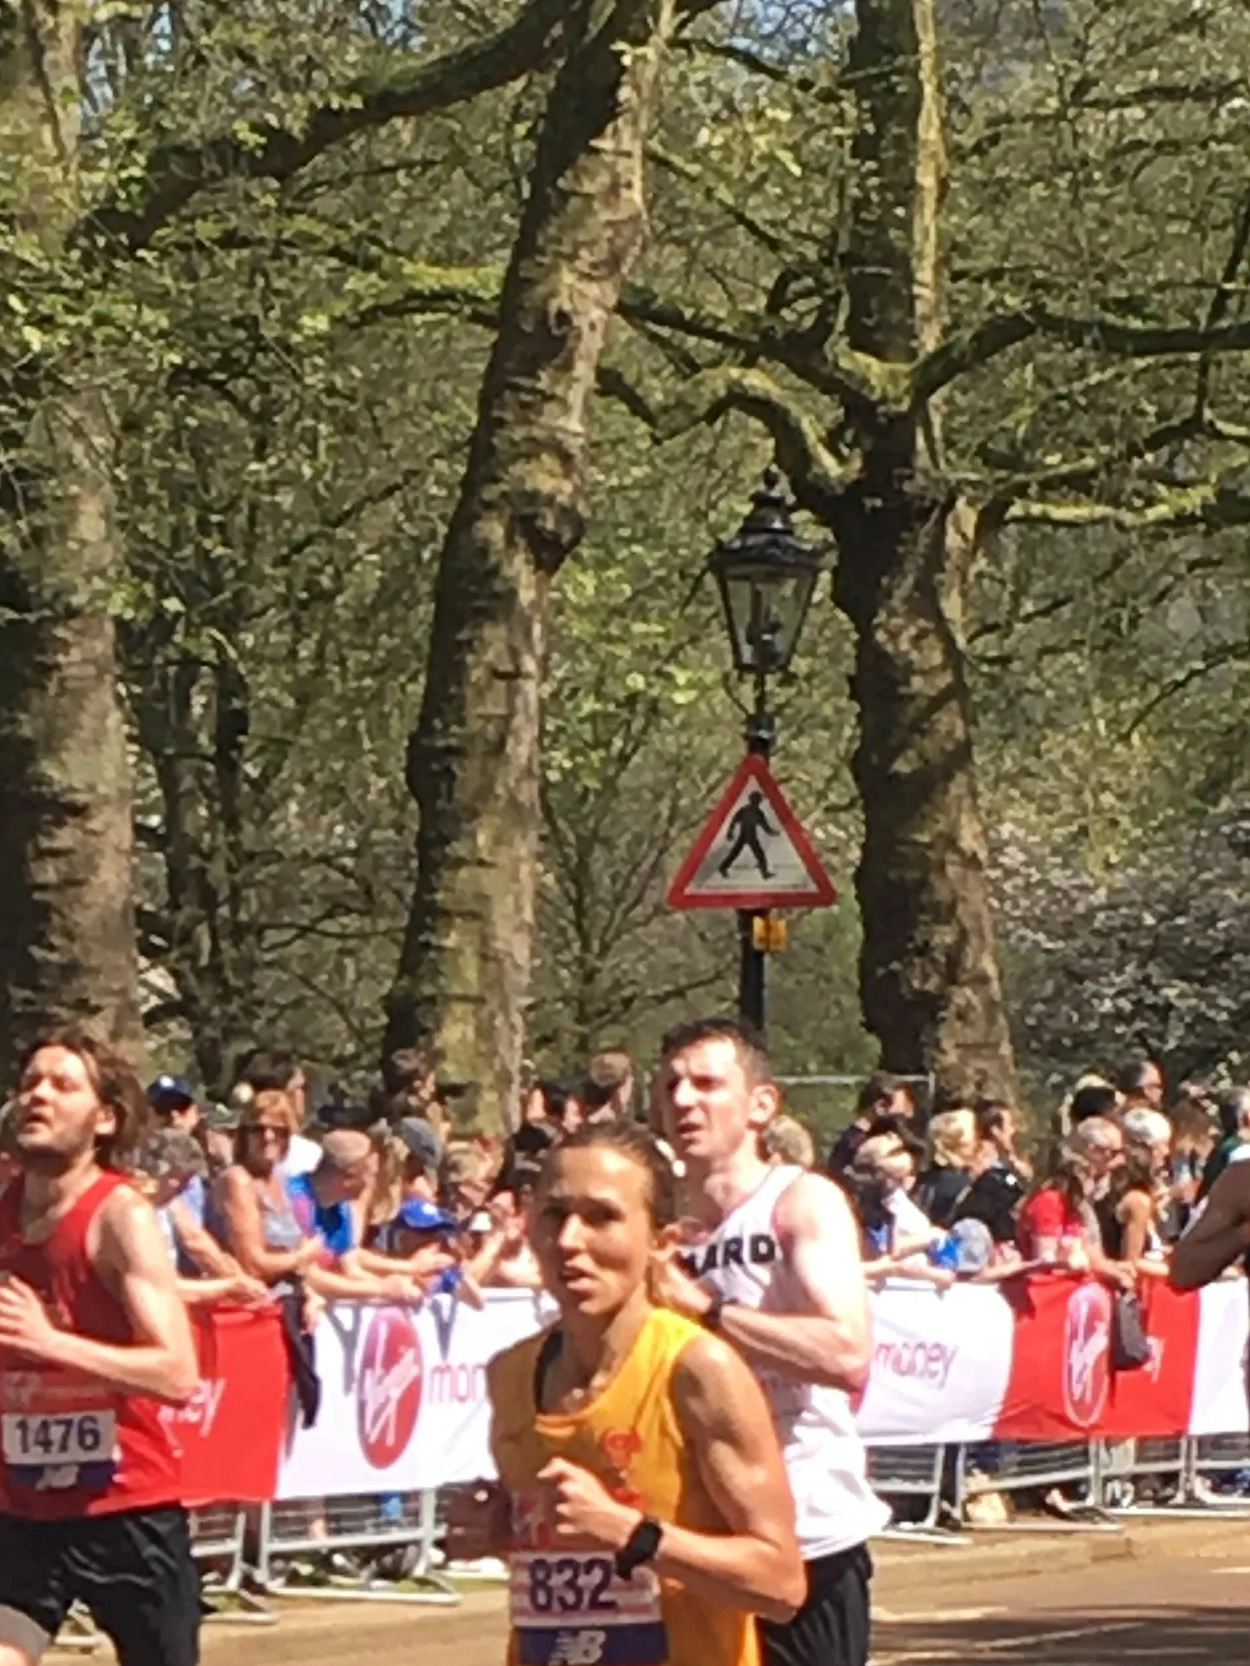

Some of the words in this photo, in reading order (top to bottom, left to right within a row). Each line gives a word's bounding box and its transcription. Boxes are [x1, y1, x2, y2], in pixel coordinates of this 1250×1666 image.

[876, 1341, 960, 1390] money
[15, 1415, 100, 1454] 1476
[528, 1557, 618, 1612] 832
